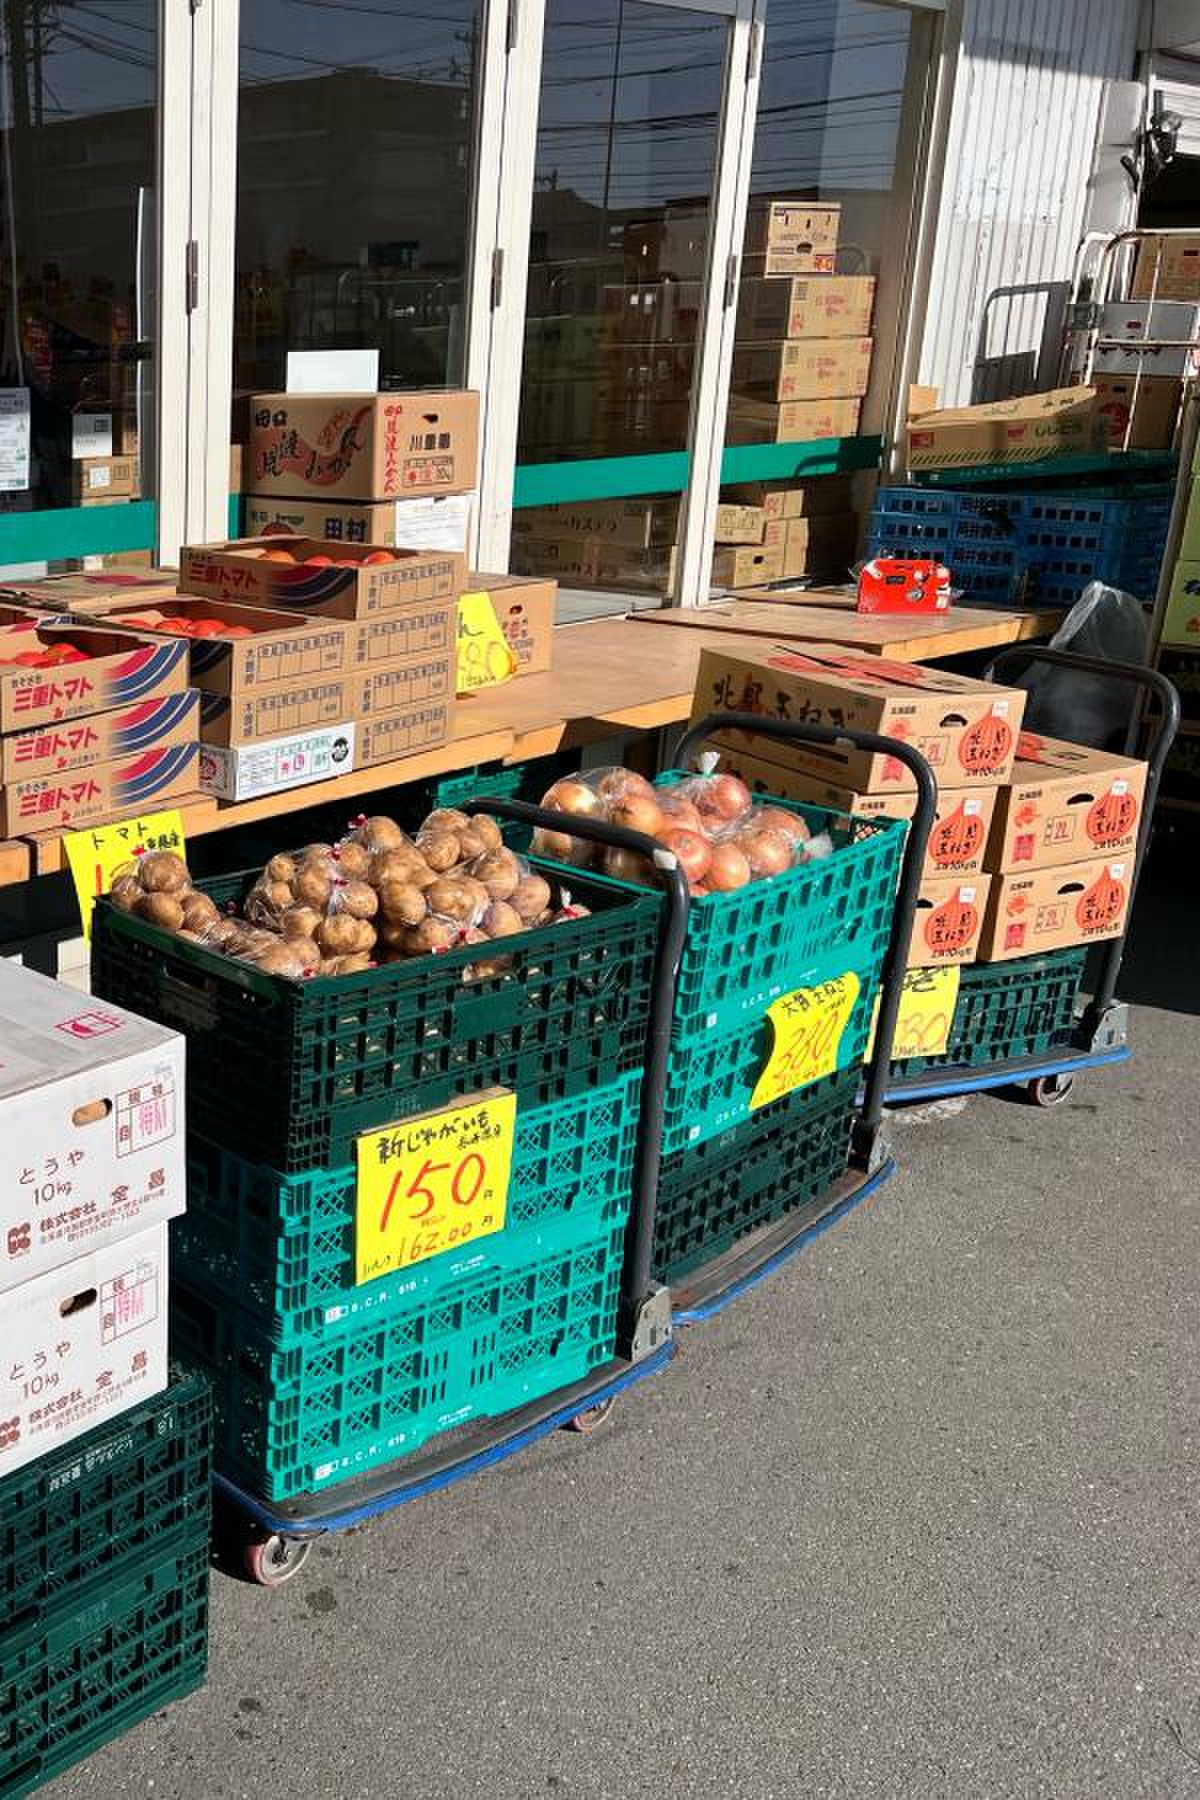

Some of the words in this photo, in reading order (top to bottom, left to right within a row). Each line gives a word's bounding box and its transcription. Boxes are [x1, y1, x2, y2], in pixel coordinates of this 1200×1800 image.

[13, 677, 94, 713] 三重トマト
[15, 727, 100, 763] 三重トマト
[19, 780, 102, 817] 三重トマト
[92, 821, 148, 850] トマト
[376, 1110, 489, 1165] 新じゃがいも
[19, 1150, 85, 1185] とうや
[34, 1181, 73, 1206] 10kg
[379, 1152, 487, 1233] 150
[398, 1221, 473, 1267] 162.00
[10, 1340, 71, 1381] とうや
[23, 1372, 60, 1399] 10kg
